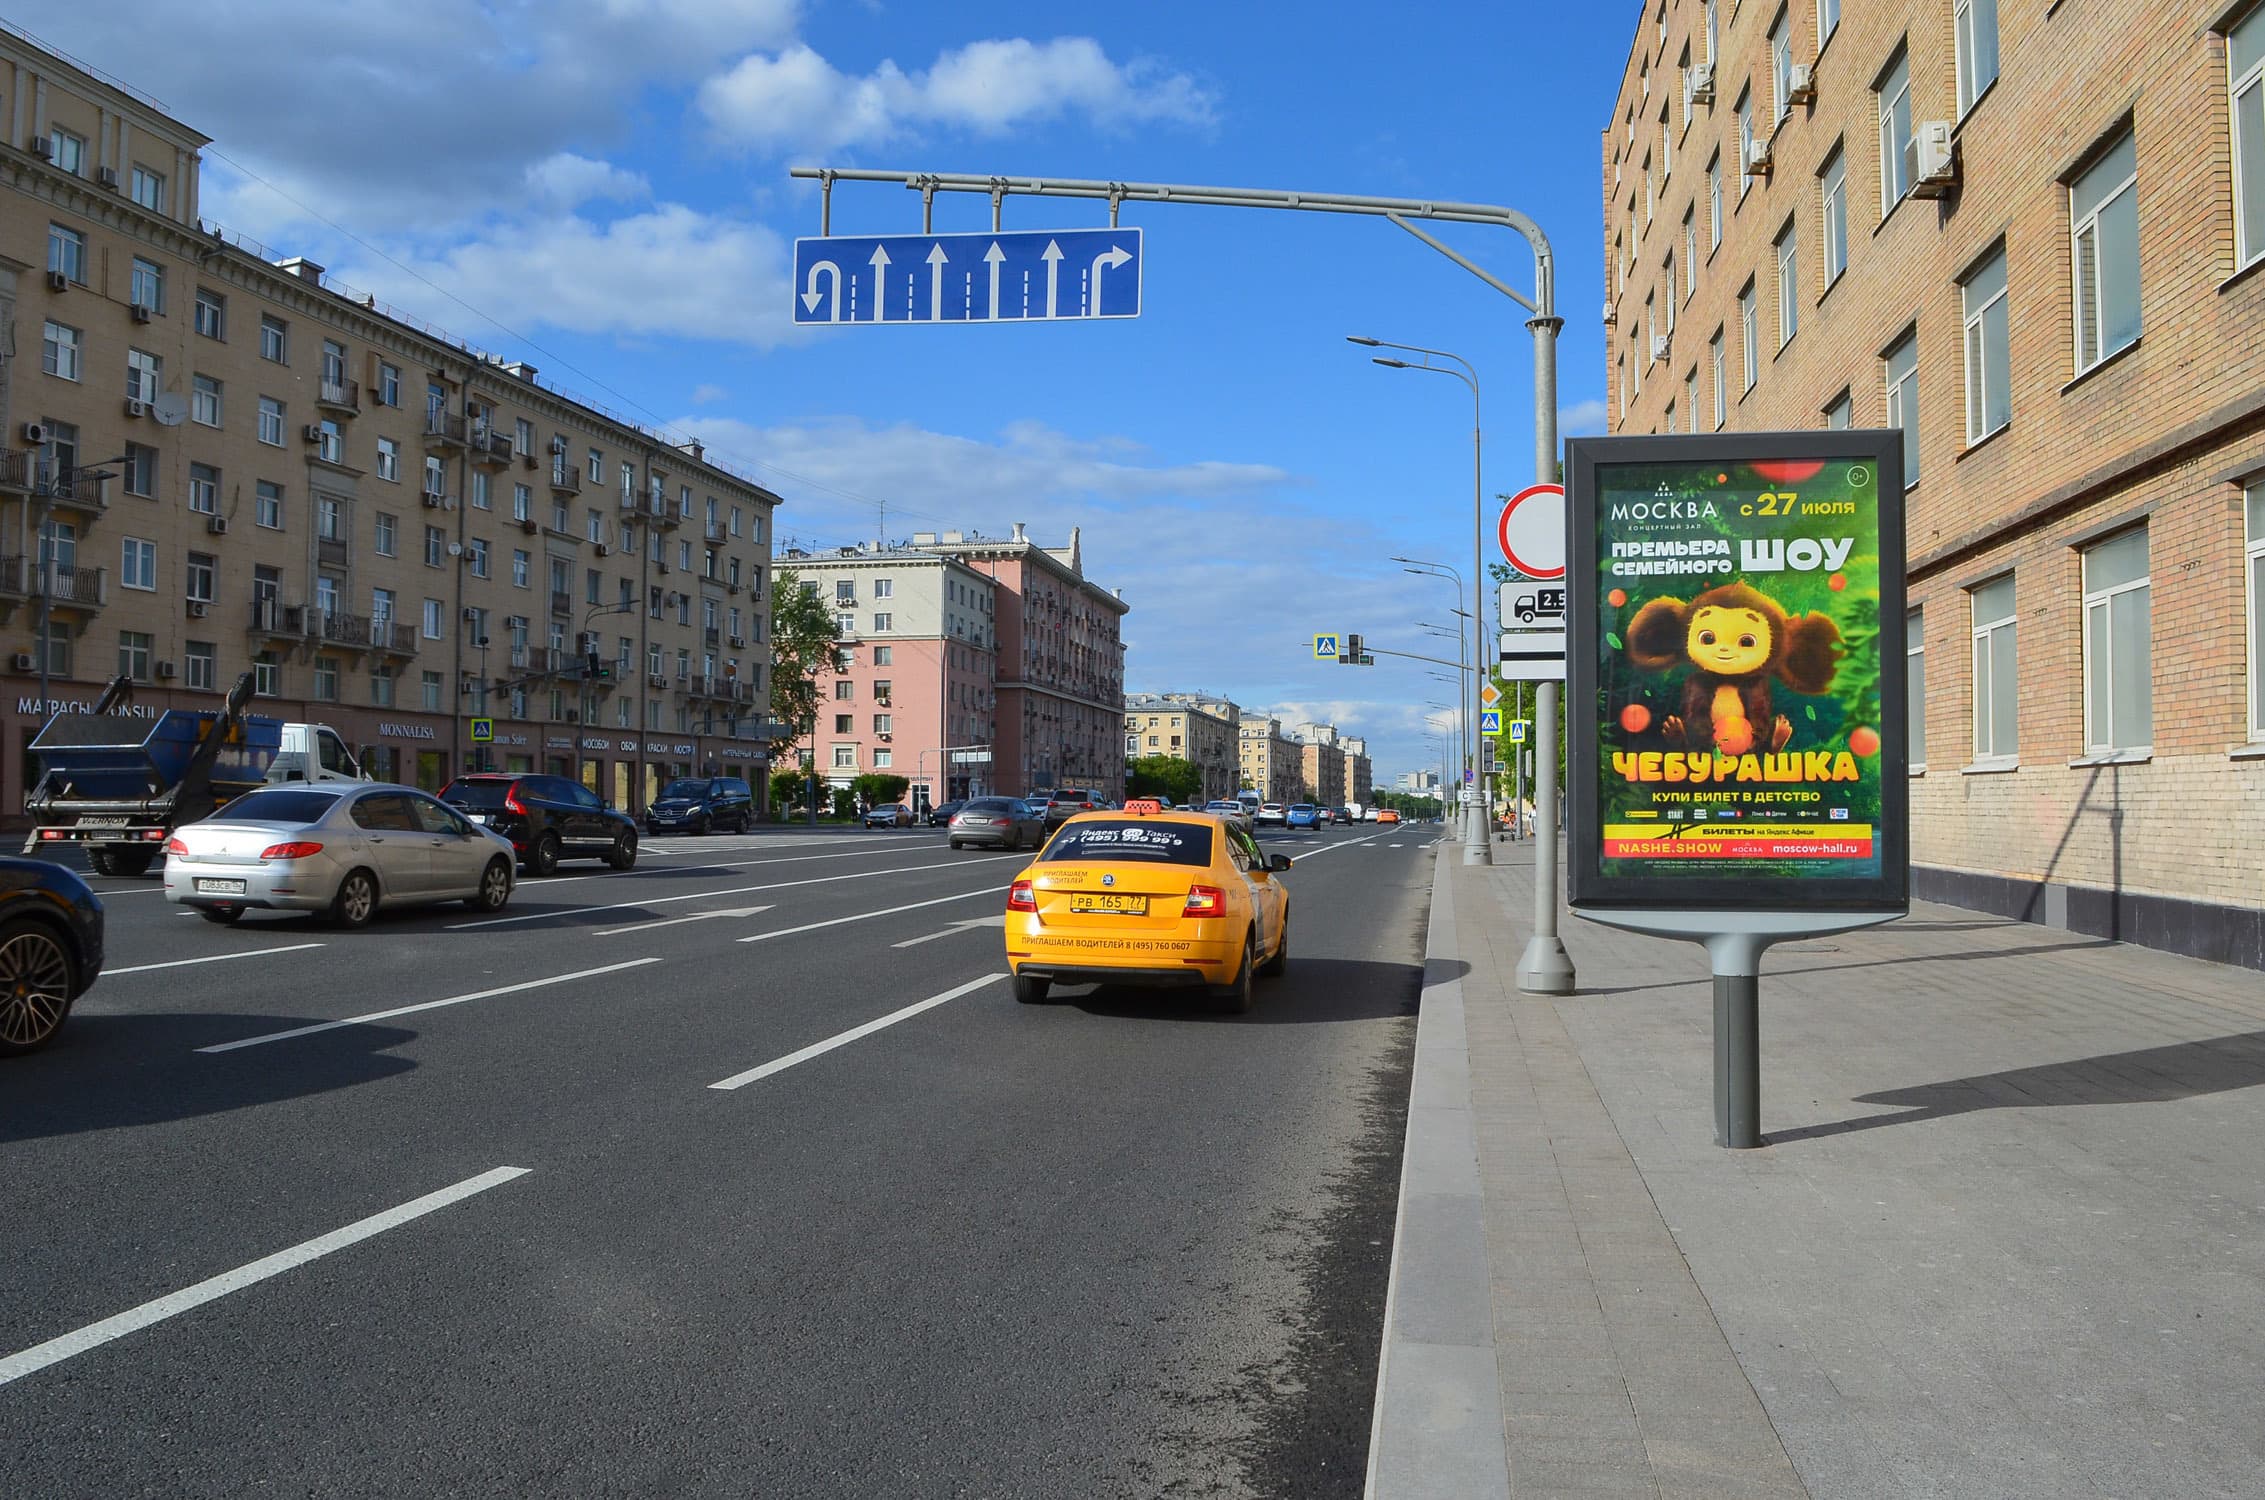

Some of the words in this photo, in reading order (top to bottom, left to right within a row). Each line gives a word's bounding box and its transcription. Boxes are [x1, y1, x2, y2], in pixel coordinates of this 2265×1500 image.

[1611, 501, 1718, 520] МОСКВА
[1757, 492, 1798, 516] 27
[1628, 523, 1682, 532] КОНЦЕРТНЫЙ
[1611, 539, 1731, 558] ПРЕМЬЕРА
[1740, 537, 1855, 572] ШОУ
[1611, 558, 1733, 576] СЕМЕЙНОГО
[379, 722, 435, 740] MONNALISA
[1611, 751, 1860, 783] ЧЕБУРАШКА
[1652, 792, 1690, 802] КУПИ
[1694, 792, 1739, 802] БИЛЕТ
[1743, 792, 1752, 802] В
[1754, 791, 1821, 802] ДЕТСТВО
[1080, 829, 1120, 838] Яндекс
[1146, 829, 1176, 839] Такси
[1080, 834, 1118, 843] (495)
[1618, 843, 1722, 854] NASHE.SHOW
[1773, 843, 1858, 854] moscow-hall.ru
[1099, 895, 1122, 909] 165
[1021, 936, 1074, 947] ПРИГЛАШАЕМ
[1075, 938, 1124, 950] ВОДИТЕЛЕЙ
[1125, 941, 1131, 950] 8
[1133, 940, 1153, 951] (495)
[1155, 941, 1170, 951] 760
[1171, 941, 1191, 951] 0607
